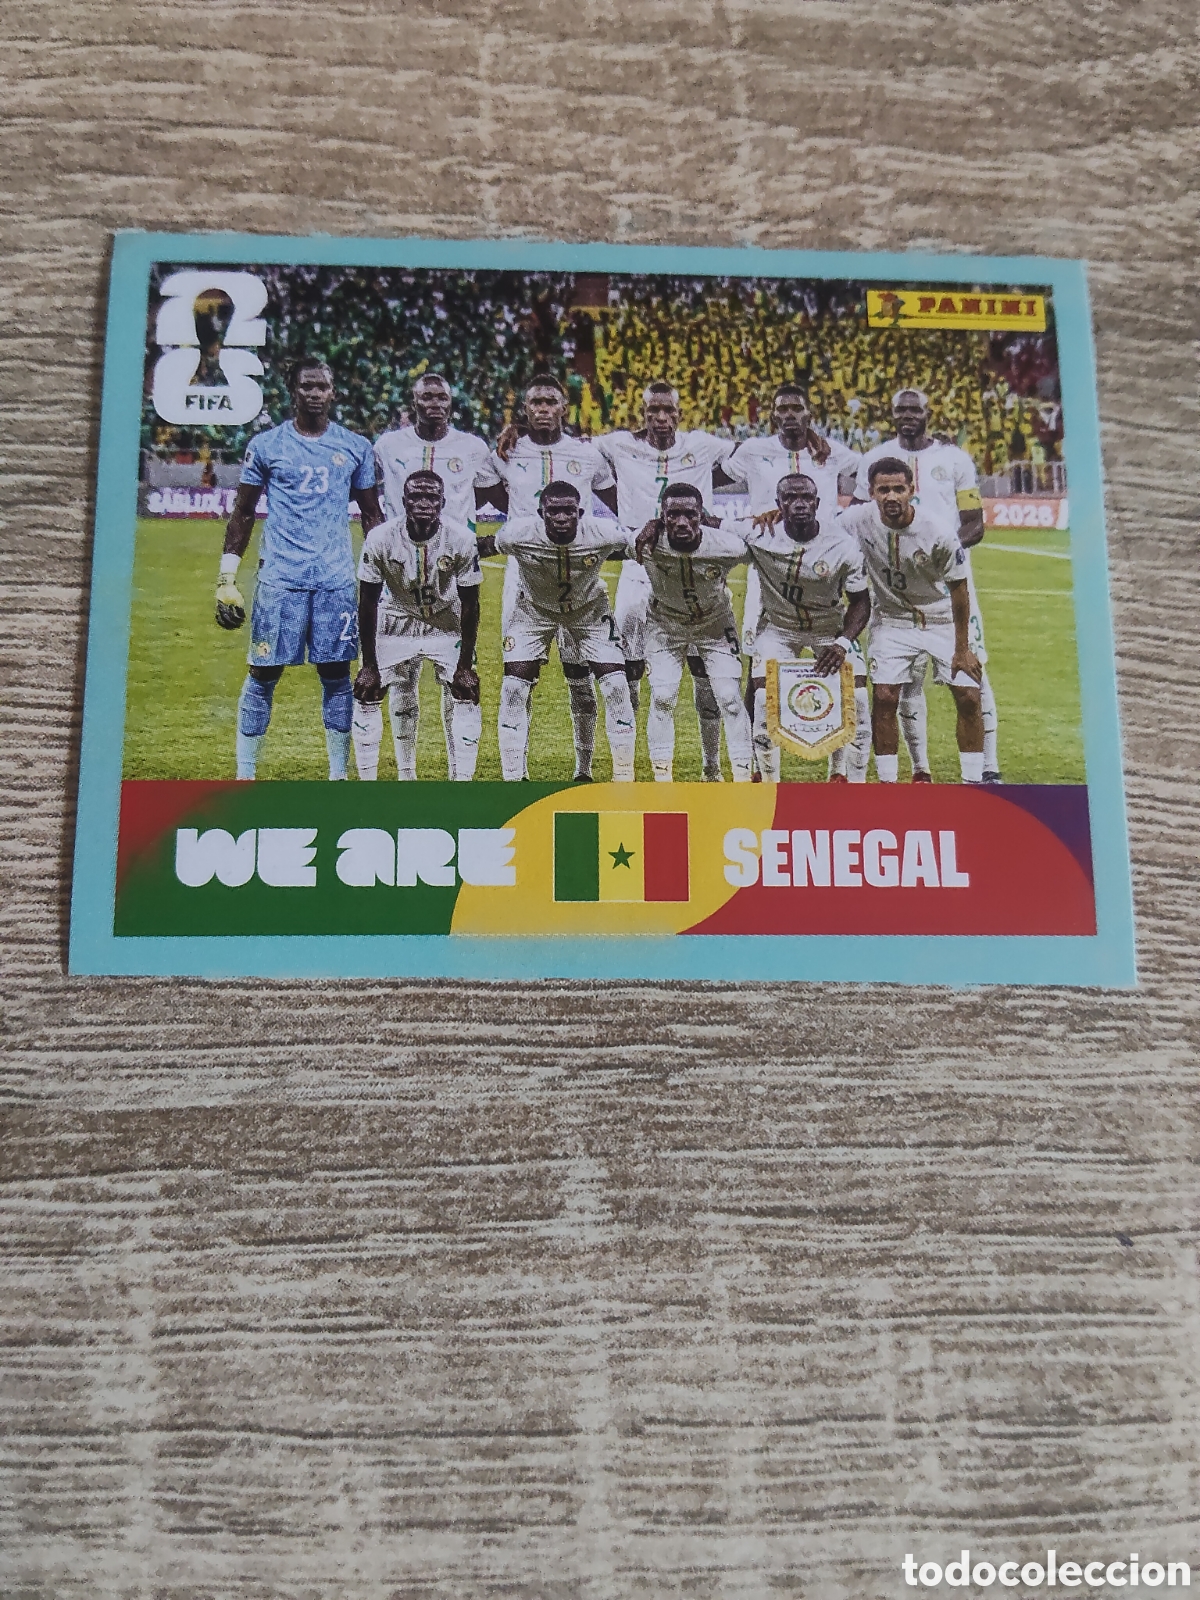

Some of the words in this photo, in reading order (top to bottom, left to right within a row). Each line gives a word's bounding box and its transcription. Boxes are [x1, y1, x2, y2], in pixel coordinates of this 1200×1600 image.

[917, 297, 1036, 316] PANINI
[185, 394, 234, 411] FIFA
[299, 465, 329, 494] 23
[655, 477, 668, 503] 7
[558, 582, 571, 602] 2
[780, 582, 803, 602] 10
[881, 568, 907, 590] 13
[683, 589, 698, 604] 5
[601, 615, 620, 641] 2
[724, 627, 739, 654] 5
[970, 615, 981, 641] 3
[175, 828, 318, 887] WE
[335, 828, 516, 887] ARE
[723, 827, 970, 887] SENEGAL
